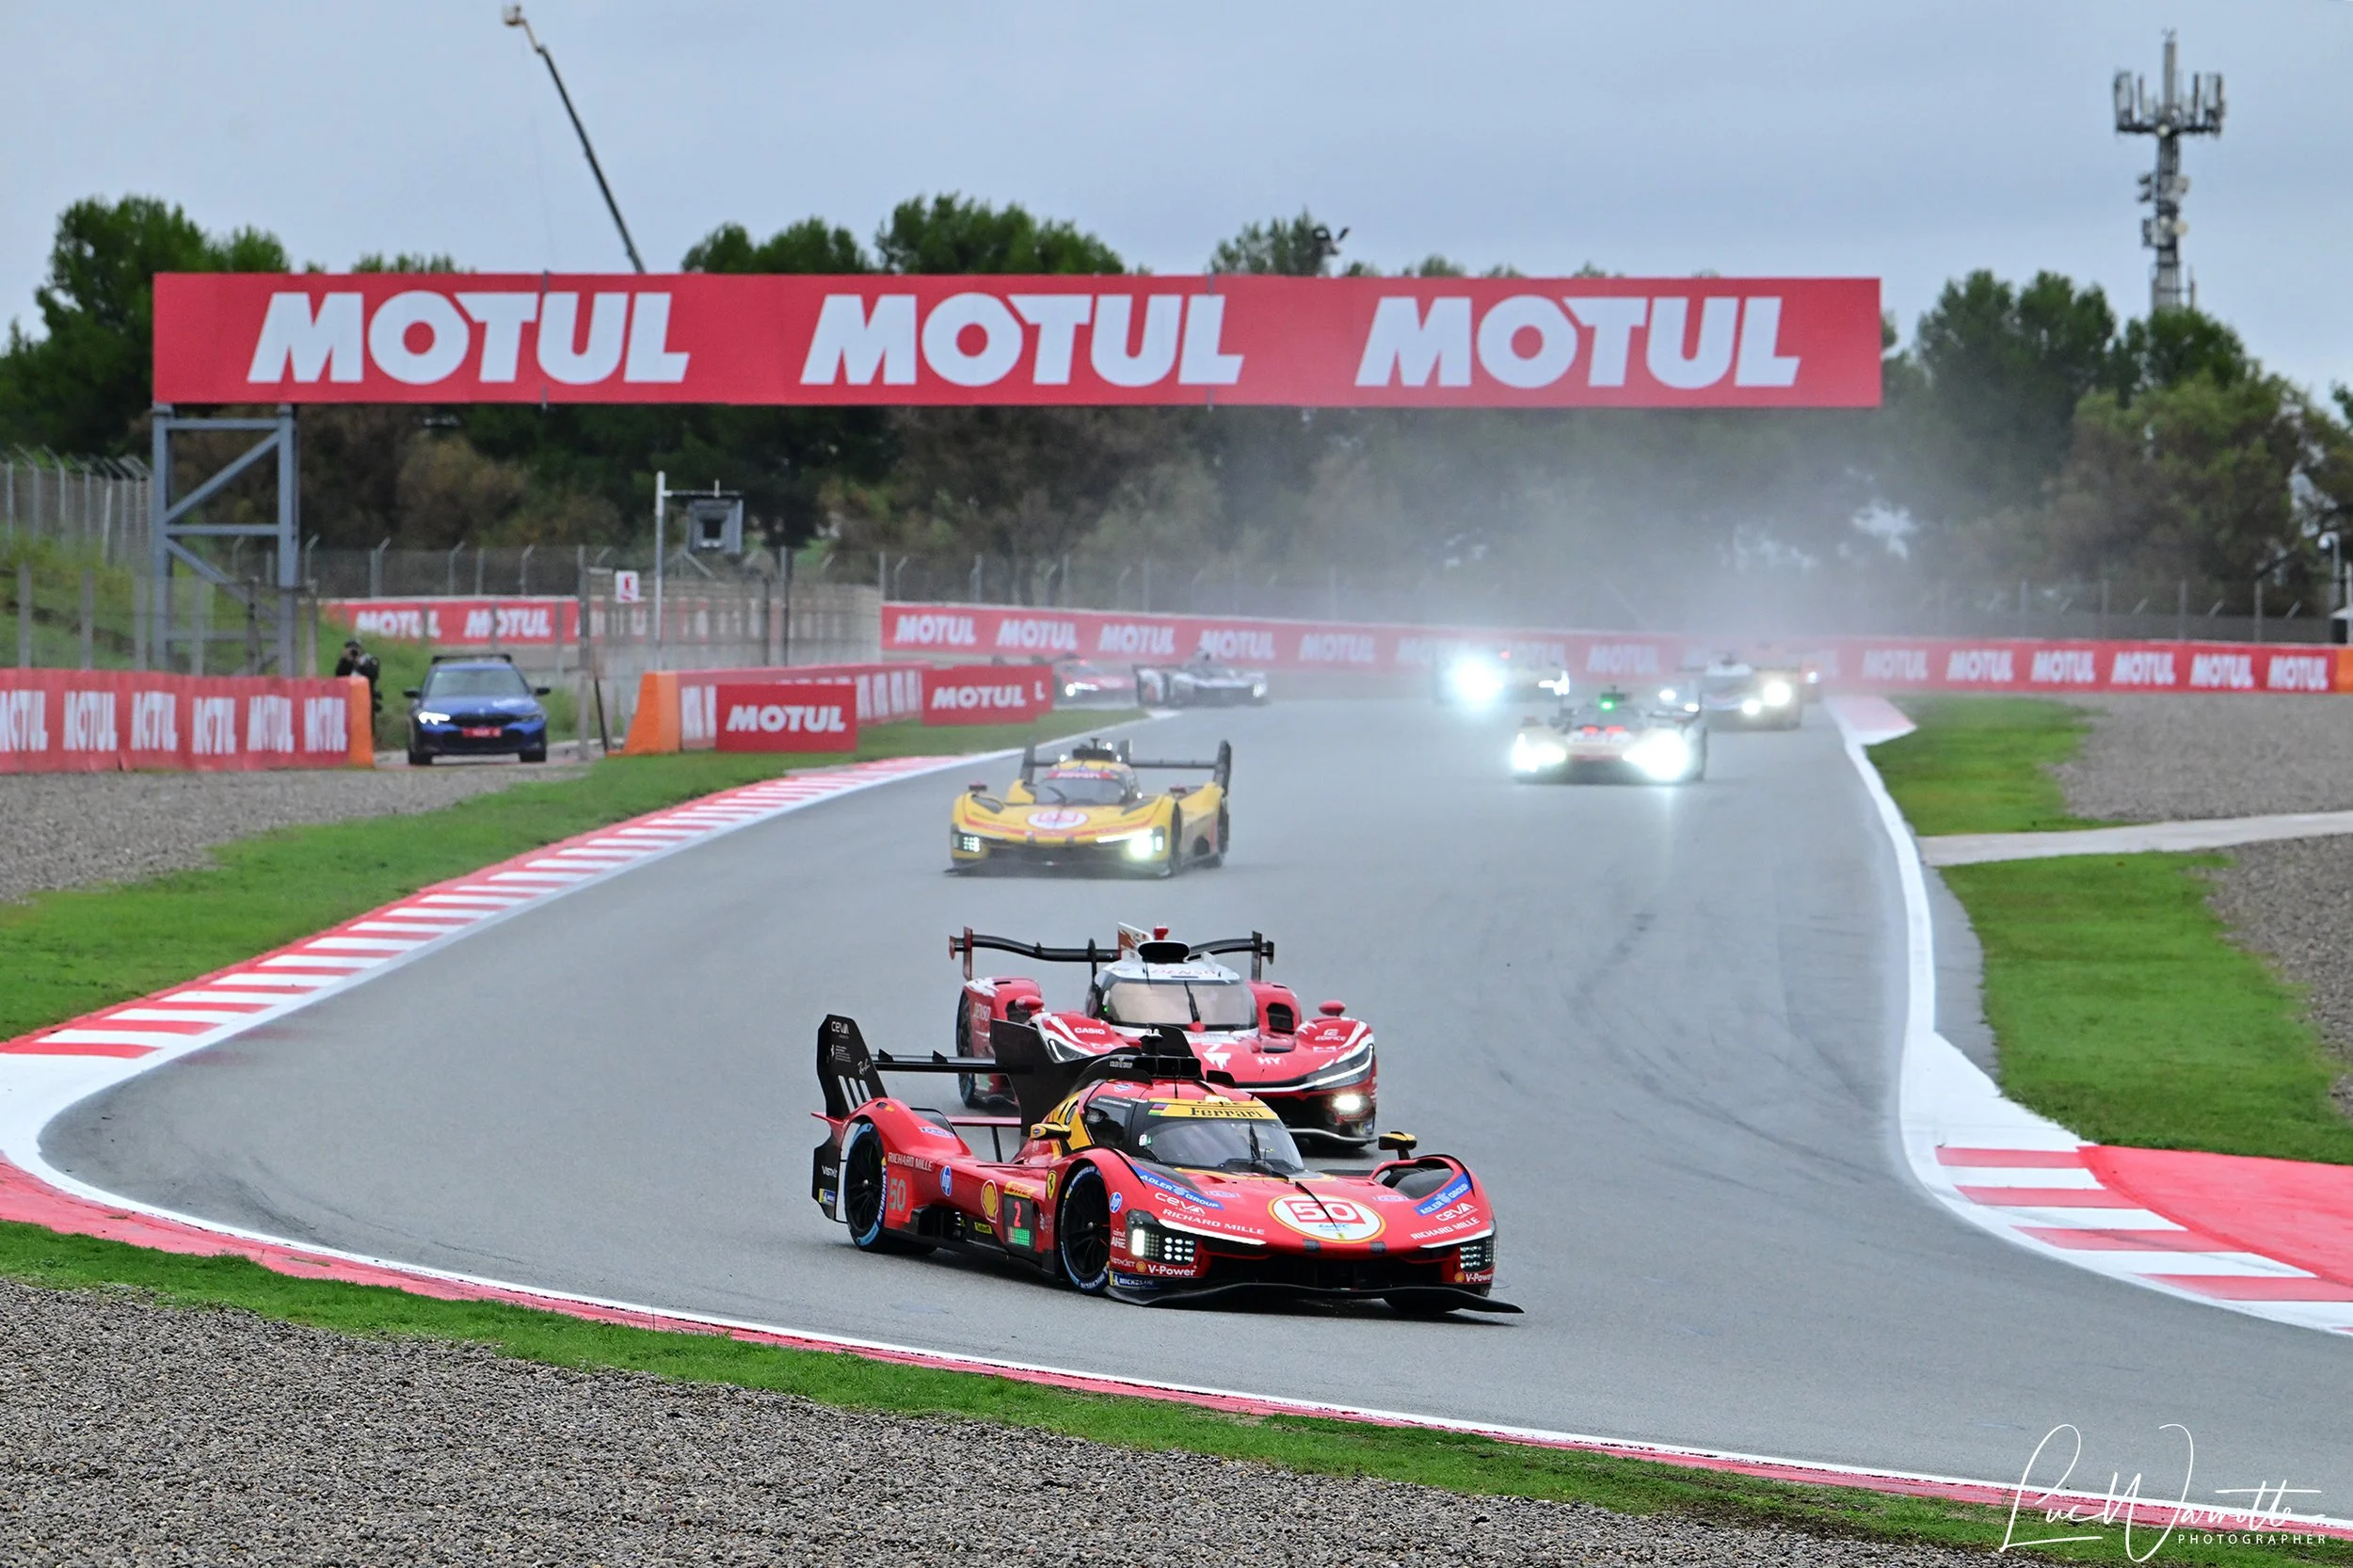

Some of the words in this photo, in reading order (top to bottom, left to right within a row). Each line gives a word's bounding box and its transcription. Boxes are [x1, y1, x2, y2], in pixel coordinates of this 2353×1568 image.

[248, 290, 690, 385] MOTUL
[800, 292, 1244, 388] MOTUL
[1354, 294, 1801, 389] MOTUL
[894, 615, 977, 646] MOTUL
[997, 619, 1078, 649] MOTUL
[1098, 623, 1175, 655] MOTUL
[1946, 649, 2014, 682] MOTUL
[2031, 651, 2095, 683] MOTUL
[2111, 652, 2176, 685] MOTUL
[2190, 653, 2254, 688] MOTUL
[2267, 655, 2328, 691] MOTUL
[932, 685, 1027, 709] MOTUL
[726, 704, 846, 733] MOTUL
[1074, 1027, 1106, 1035] CASIO
[1190, 1107, 1264, 1119] Ferrari
[889, 1177, 906, 1211] 50
[1140, 1175, 1173, 1191] ADLER
[1185, 1192, 1220, 1208] GROUP
[1154, 1192, 1206, 1213] CEVA
[1014, 1201, 1021, 1227] 2
[1162, 1208, 1221, 1227] RICHARD
[1225, 1223, 1265, 1236] MILLE
[1289, 1202, 1358, 1222] 50
[1434, 1202, 1475, 1222] CEVA
[1410, 1226, 1454, 1240] RICHARD
[1452, 1216, 1481, 1230] MILLE
[1147, 1264, 1195, 1276] V-Power
